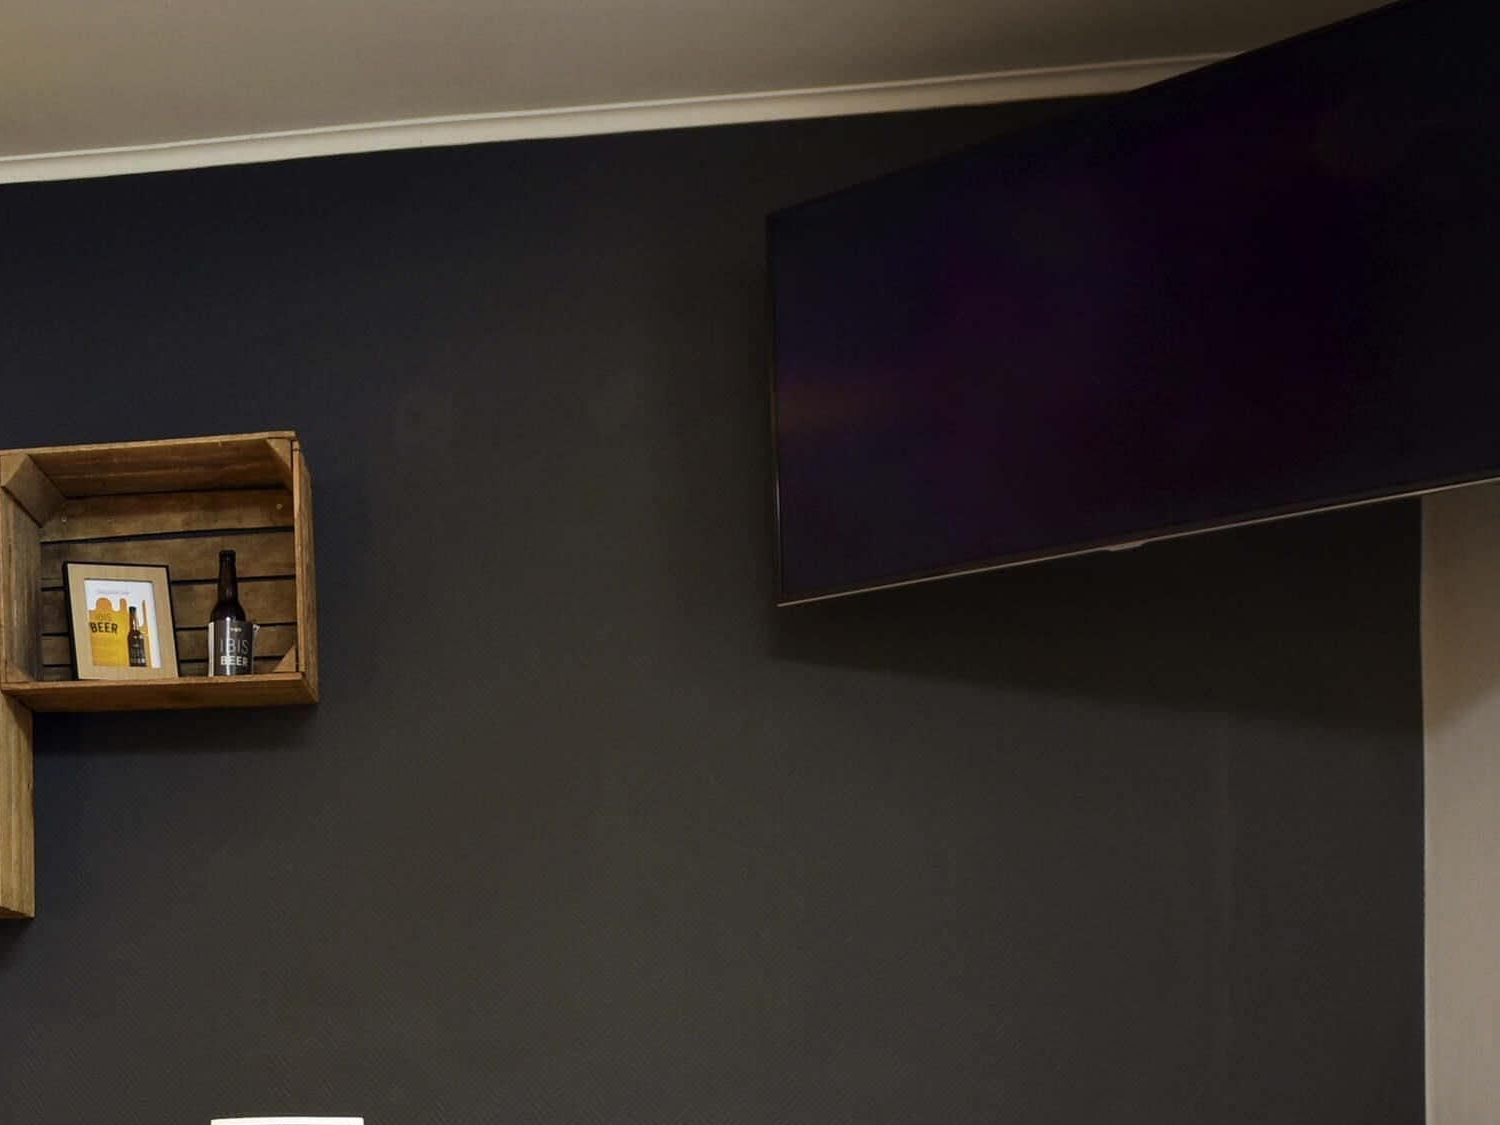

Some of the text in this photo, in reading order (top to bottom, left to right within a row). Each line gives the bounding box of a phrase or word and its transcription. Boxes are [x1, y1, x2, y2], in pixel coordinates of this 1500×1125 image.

[90, 622, 118, 633] BEER
[220, 639, 249, 655] IBIS
[220, 655, 249, 666] BEER
